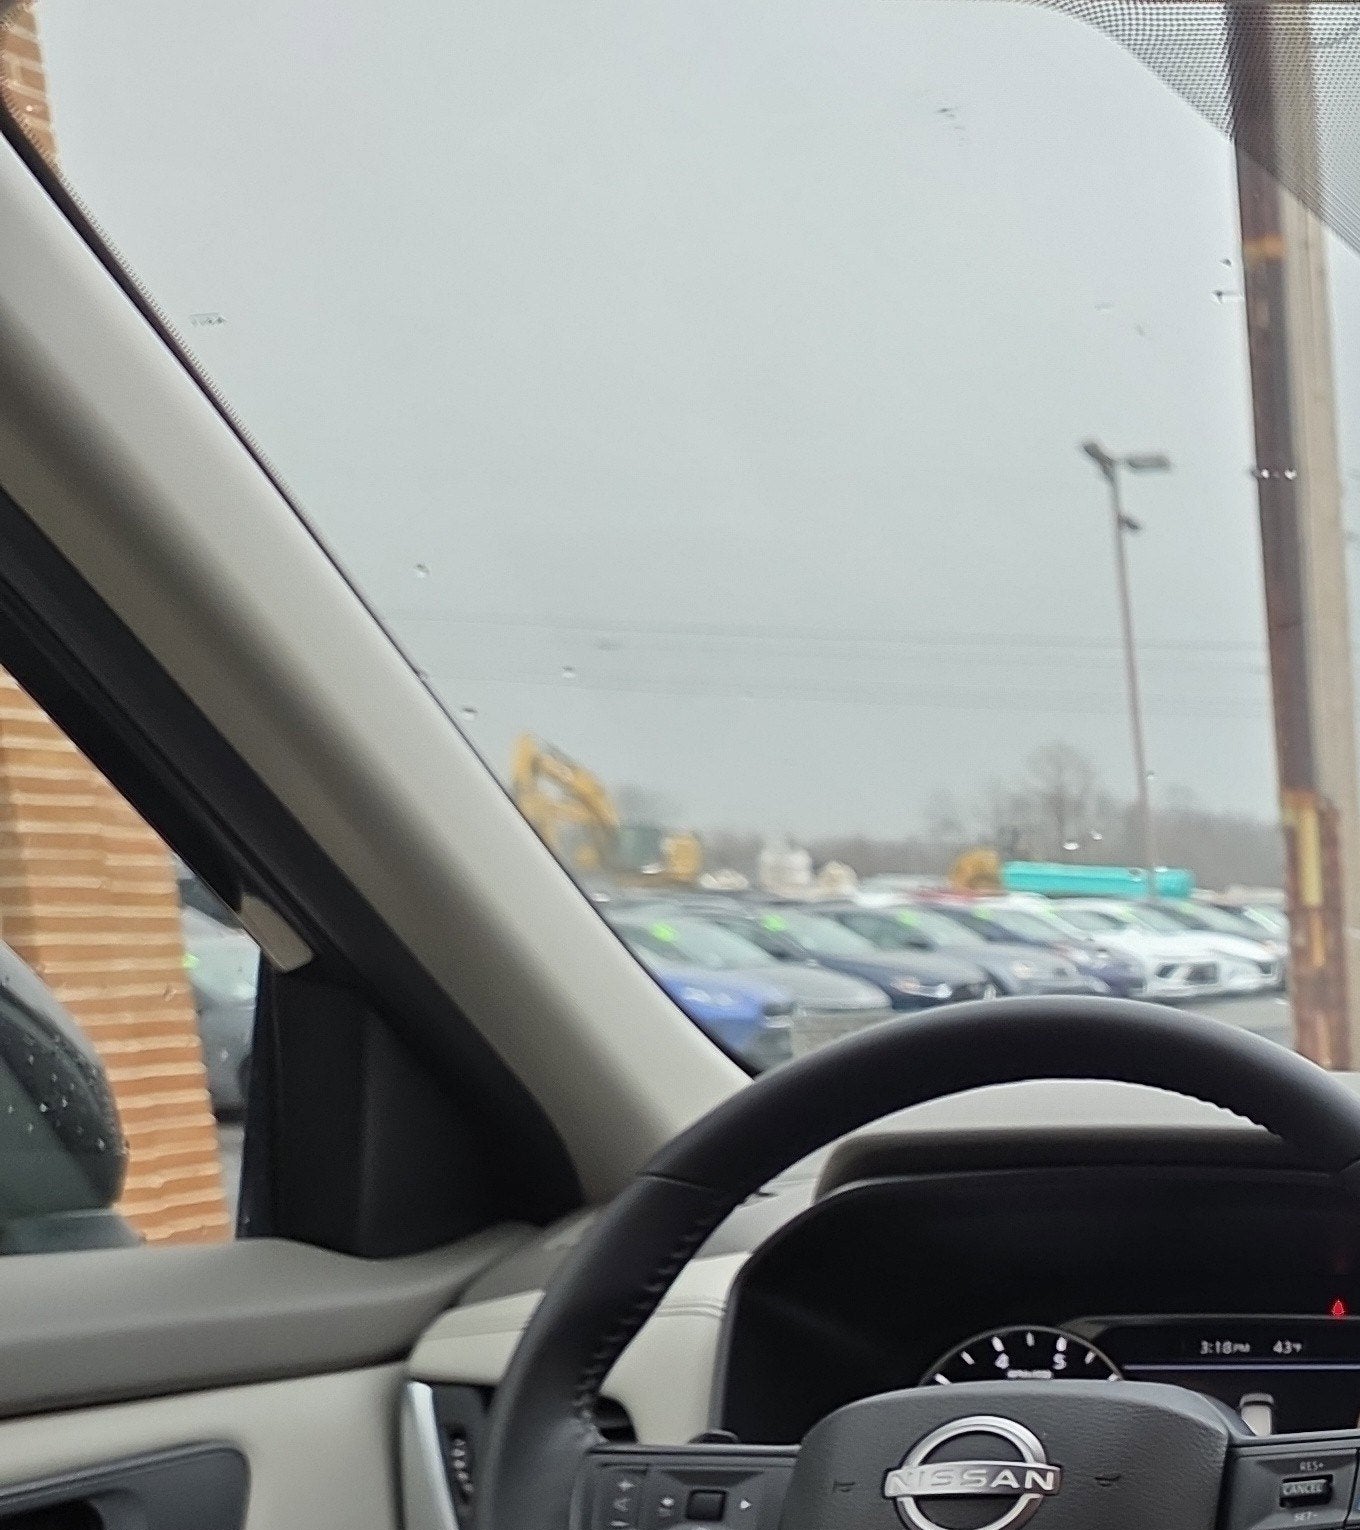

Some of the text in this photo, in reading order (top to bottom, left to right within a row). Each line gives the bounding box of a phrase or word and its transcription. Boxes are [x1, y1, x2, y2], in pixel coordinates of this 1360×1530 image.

[1053, 1353, 1067, 1370] 5
[888, 1469, 1055, 1493] NISSAN
[1283, 1482, 1325, 1496] CANCEL
